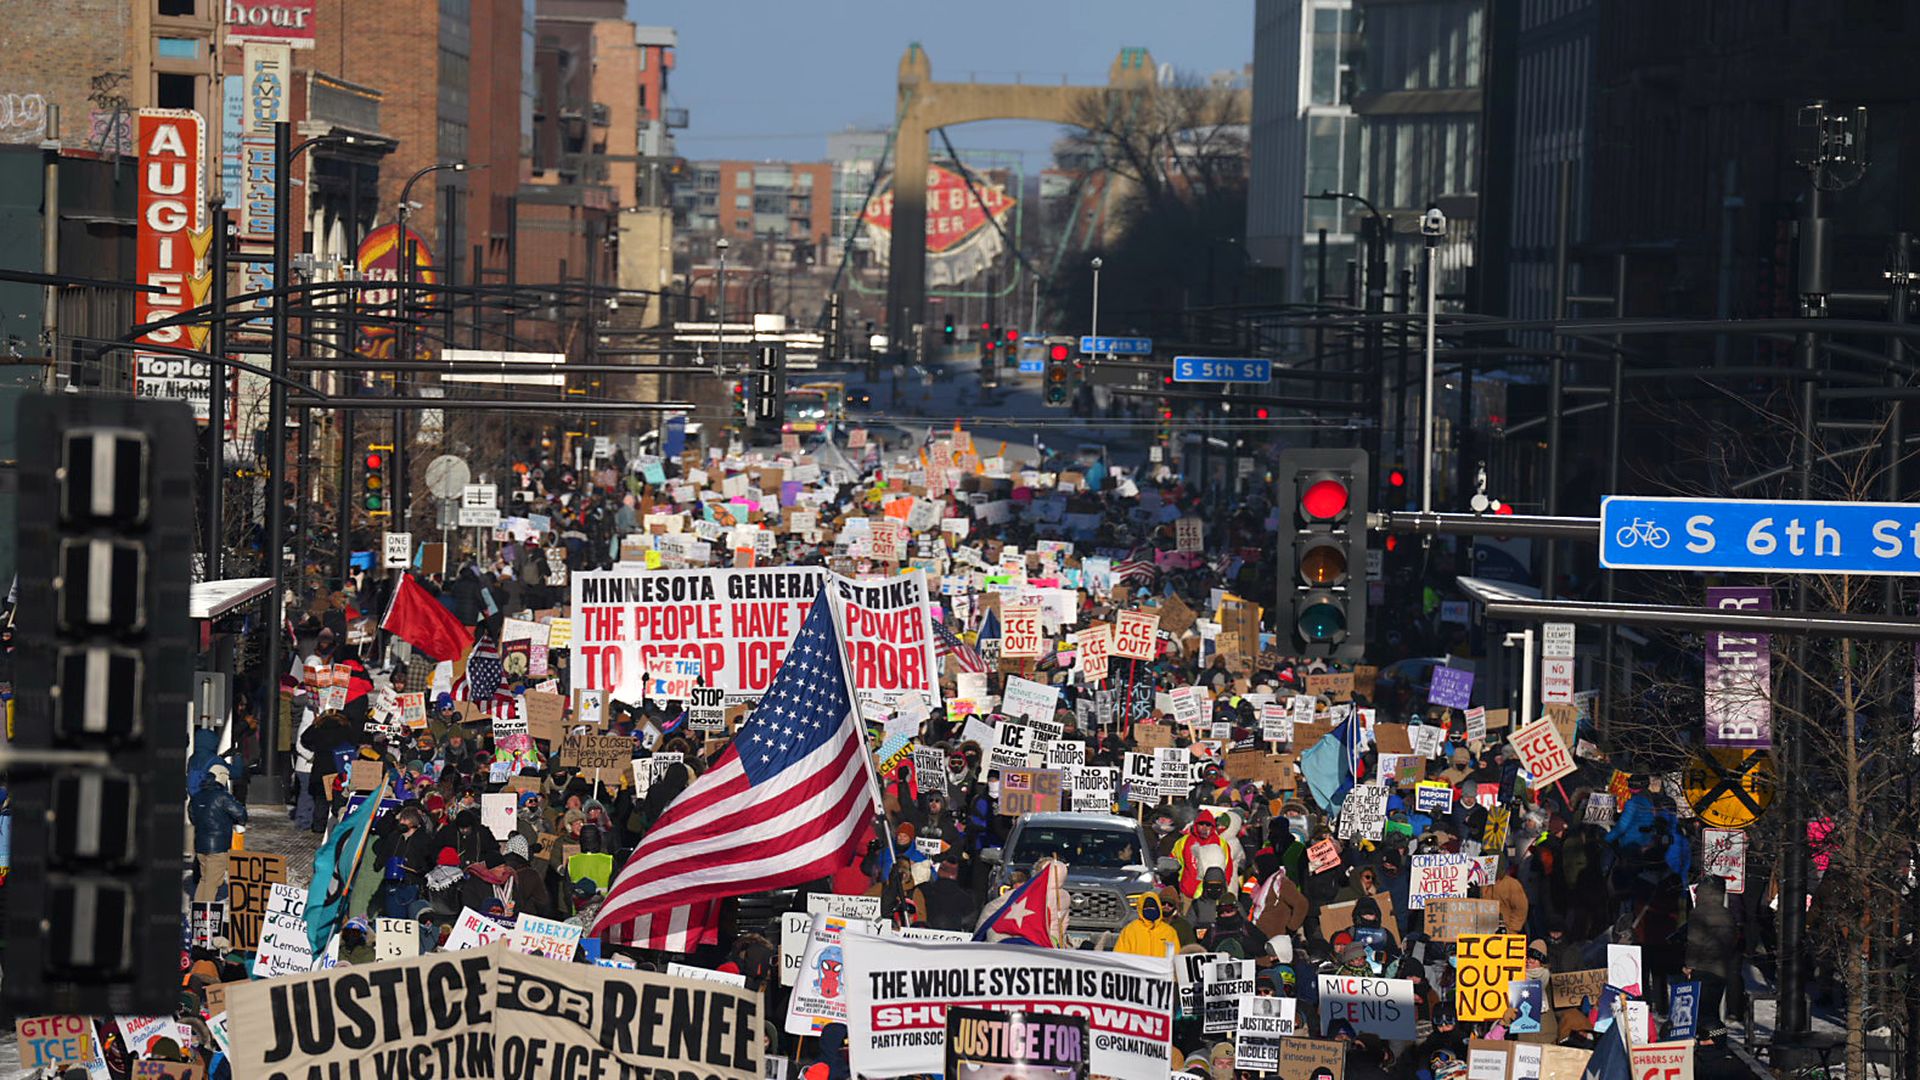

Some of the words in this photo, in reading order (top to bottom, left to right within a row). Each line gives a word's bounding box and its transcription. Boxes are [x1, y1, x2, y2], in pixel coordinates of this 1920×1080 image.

[224, 0, 311, 30] hour
[867, 190, 940, 217] GRN
[950, 184, 1005, 210] BELT
[926, 216, 965, 235] EER
[1182, 363, 1193, 377] S
[1202, 363, 1234, 378] 5th
[1244, 364, 1263, 378] St
[388, 536, 407, 545] ONE
[872, 531, 892, 542] ICE
[1684, 515, 1716, 554] S
[1746, 516, 1842, 557] 6th
[1872, 519, 1920, 560] St
[388, 545, 407, 553] WAY
[872, 543, 896, 554] OUT!
[582, 575, 715, 603] MINNESOTA
[838, 579, 920, 610] STRIKE:
[581, 606, 626, 641] THE
[635, 603, 723, 641] PEOPLE
[731, 602, 790, 638] HAVE
[846, 602, 924, 644] POWER
[1005, 619, 1035, 634] ICE
[1119, 621, 1151, 639] ICE
[1005, 636, 1037, 650] OUT!
[1081, 638, 1107, 657] ICE
[1117, 637, 1151, 655] OUT!
[581, 645, 623, 694] TO
[649, 660, 672, 673] WE
[675, 660, 700, 675] THE
[1084, 656, 1107, 673] OUT
[1552, 665, 1565, 674] NO
[1545, 677, 1571, 686] STOPPING
[691, 688, 723, 706] STOP
[691, 709, 702, 718] ICE
[703, 709, 723, 718] TERROR
[1549, 709, 1570, 724] MN
[1029, 720, 1061, 734] GENERAL
[587, 736, 597, 748] IS
[599, 736, 632, 748] CLOSED
[1000, 724, 1026, 748] ICE
[893, 743, 914, 763] OUT
[992, 747, 1015, 757] OUT
[1521, 732, 1557, 762] ICE
[594, 758, 617, 768] OUT
[916, 755, 943, 772] STRIKE
[991, 753, 1027, 768] MINNESOTA
[1050, 751, 1083, 765] TROOPS
[1531, 749, 1566, 778] OUT!
[1132, 755, 1154, 778] ICE
[1178, 762, 1188, 772] FOR
[1007, 774, 1029, 783] ICE
[1074, 776, 1109, 790] TROOPS
[1131, 784, 1159, 797] NNESOTA
[1421, 790, 1449, 799] DEPORT
[1006, 793, 1046, 814] OUT
[1073, 799, 1109, 809] MINNESOTA
[1361, 822, 1372, 831] TO
[1716, 838, 1732, 850] NO
[1704, 854, 1741, 867] PPING
[230, 856, 279, 883] ICE
[1423, 867, 1459, 880] SHOULD
[275, 886, 300, 899] USES
[1419, 880, 1441, 893] NOT
[1442, 879, 1458, 892] BE
[230, 883, 268, 912] DE
[280, 898, 303, 917] IC
[1429, 903, 1448, 913] THE
[383, 919, 412, 934] ICE
[523, 919, 580, 940] LIBERTY
[388, 942, 401, 956] is
[521, 935, 574, 955] JUSTICE
[1458, 936, 1525, 960] ICE
[271, 954, 309, 973] Nationa
[1458, 965, 1524, 987] OUT
[1554, 973, 1584, 988] SHOW
[869, 971, 907, 1000] THE
[912, 967, 985, 998] WHOLE
[990, 966, 1072, 996] SYSTEM
[1076, 969, 1097, 995] IS
[1101, 970, 1173, 1010] GUILTY!
[1205, 982, 1238, 997] JUSTICE
[1238, 980, 1253, 993] FOR
[1326, 978, 1389, 997] MICRO
[1560, 982, 1592, 996] FACES
[1329, 999, 1401, 1023] PENIS
[1458, 989, 1511, 1017] NO
[264, 956, 492, 1063] JUSTICE
[498, 972, 590, 1028] FOR
[600, 979, 757, 1073] RENEE
[876, 1006, 947, 1027] SHU
[1206, 1009, 1232, 1023] NICOLE
[22, 1015, 83, 1037] GTFO
[1240, 1017, 1275, 1032] JUSTICE
[1275, 1020, 1293, 1033] FOR
[1521, 1022, 1538, 1031] Good
[871, 1034, 901, 1049] PARTY
[903, 1033, 923, 1047] FOR
[1095, 1034, 1168, 1060] @PSLNATIONAL
[953, 1017, 1041, 1059] JUSTICE
[1043, 1023, 1082, 1062] FOR
[27, 1034, 88, 1068] ICE!
[373, 1031, 495, 1080] VICTIM
[503, 1034, 547, 1080] OF
[551, 1042, 610, 1080] ICE
[1238, 1046, 1267, 1059] NICOLE
[1268, 1048, 1278, 1059] GO
[1634, 1055, 1667, 1065] GHBORS
[1668, 1055, 1684, 1064] SAY
